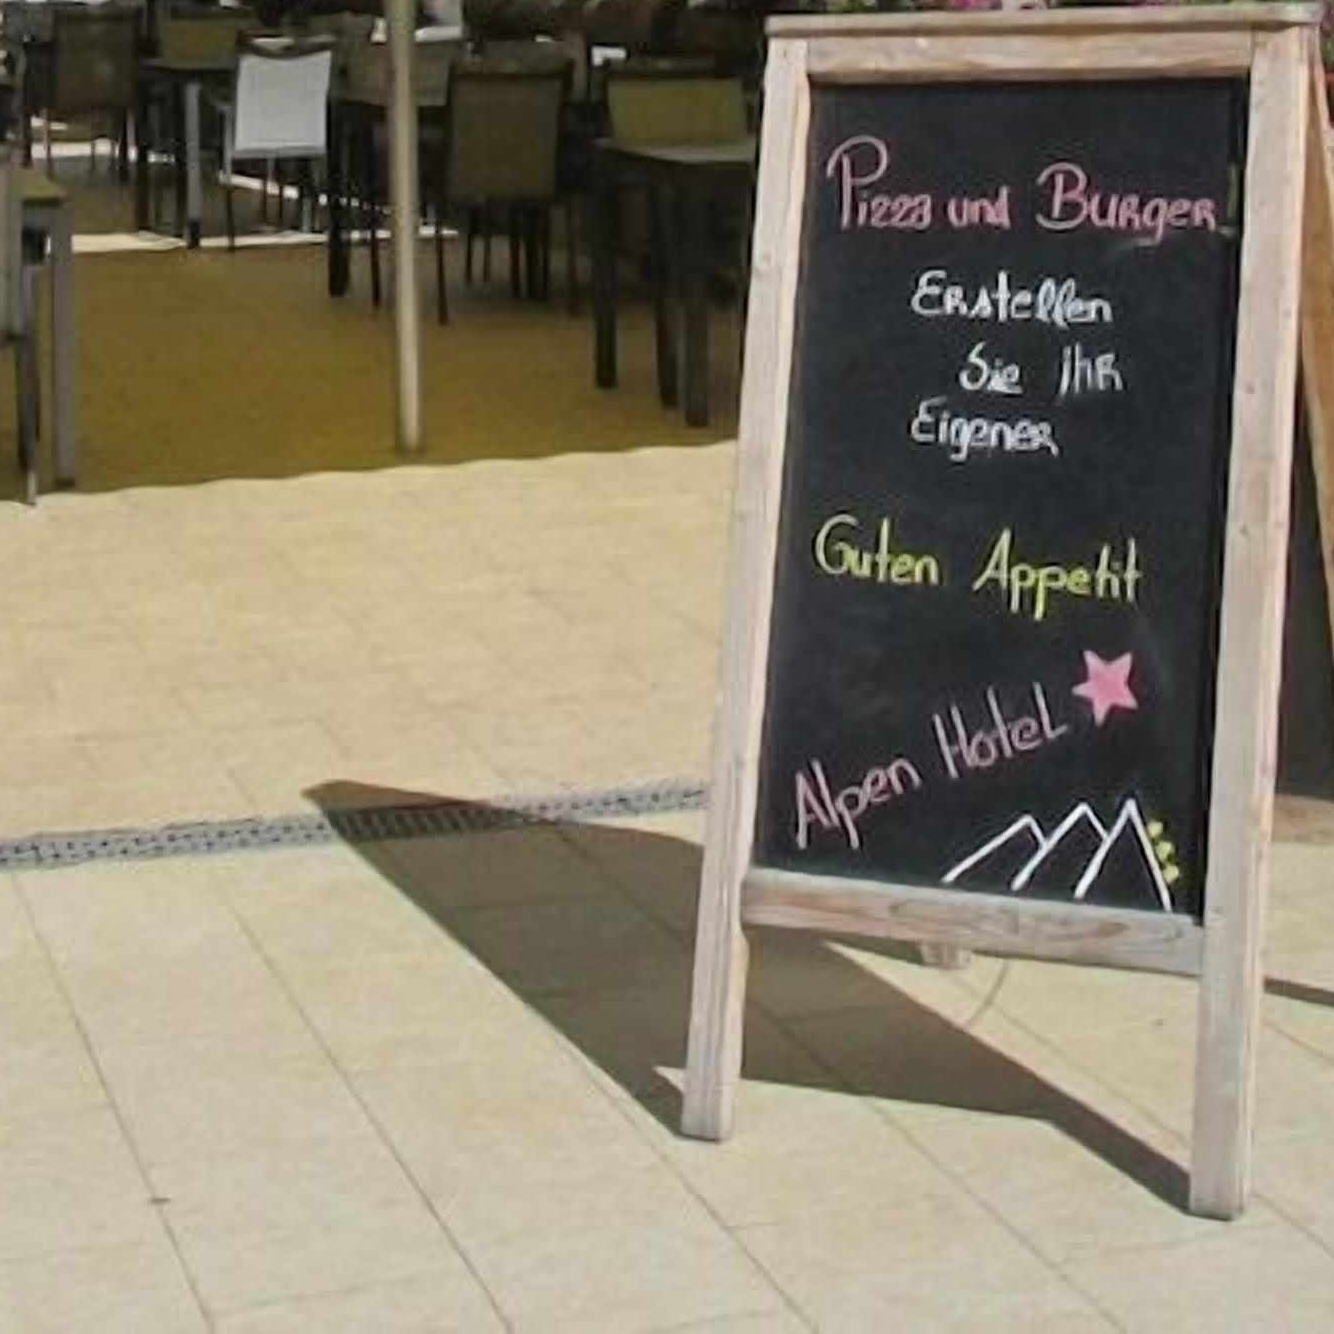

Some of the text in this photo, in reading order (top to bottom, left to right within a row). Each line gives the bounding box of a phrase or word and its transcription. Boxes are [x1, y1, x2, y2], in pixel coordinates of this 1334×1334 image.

[825, 134, 933, 231] Pizza
[946, 184, 1012, 230] und
[958, 341, 1024, 395] Sie
[814, 513, 1143, 621] Guten Appetit
[792, 681, 1069, 851] Alpen Hotel
